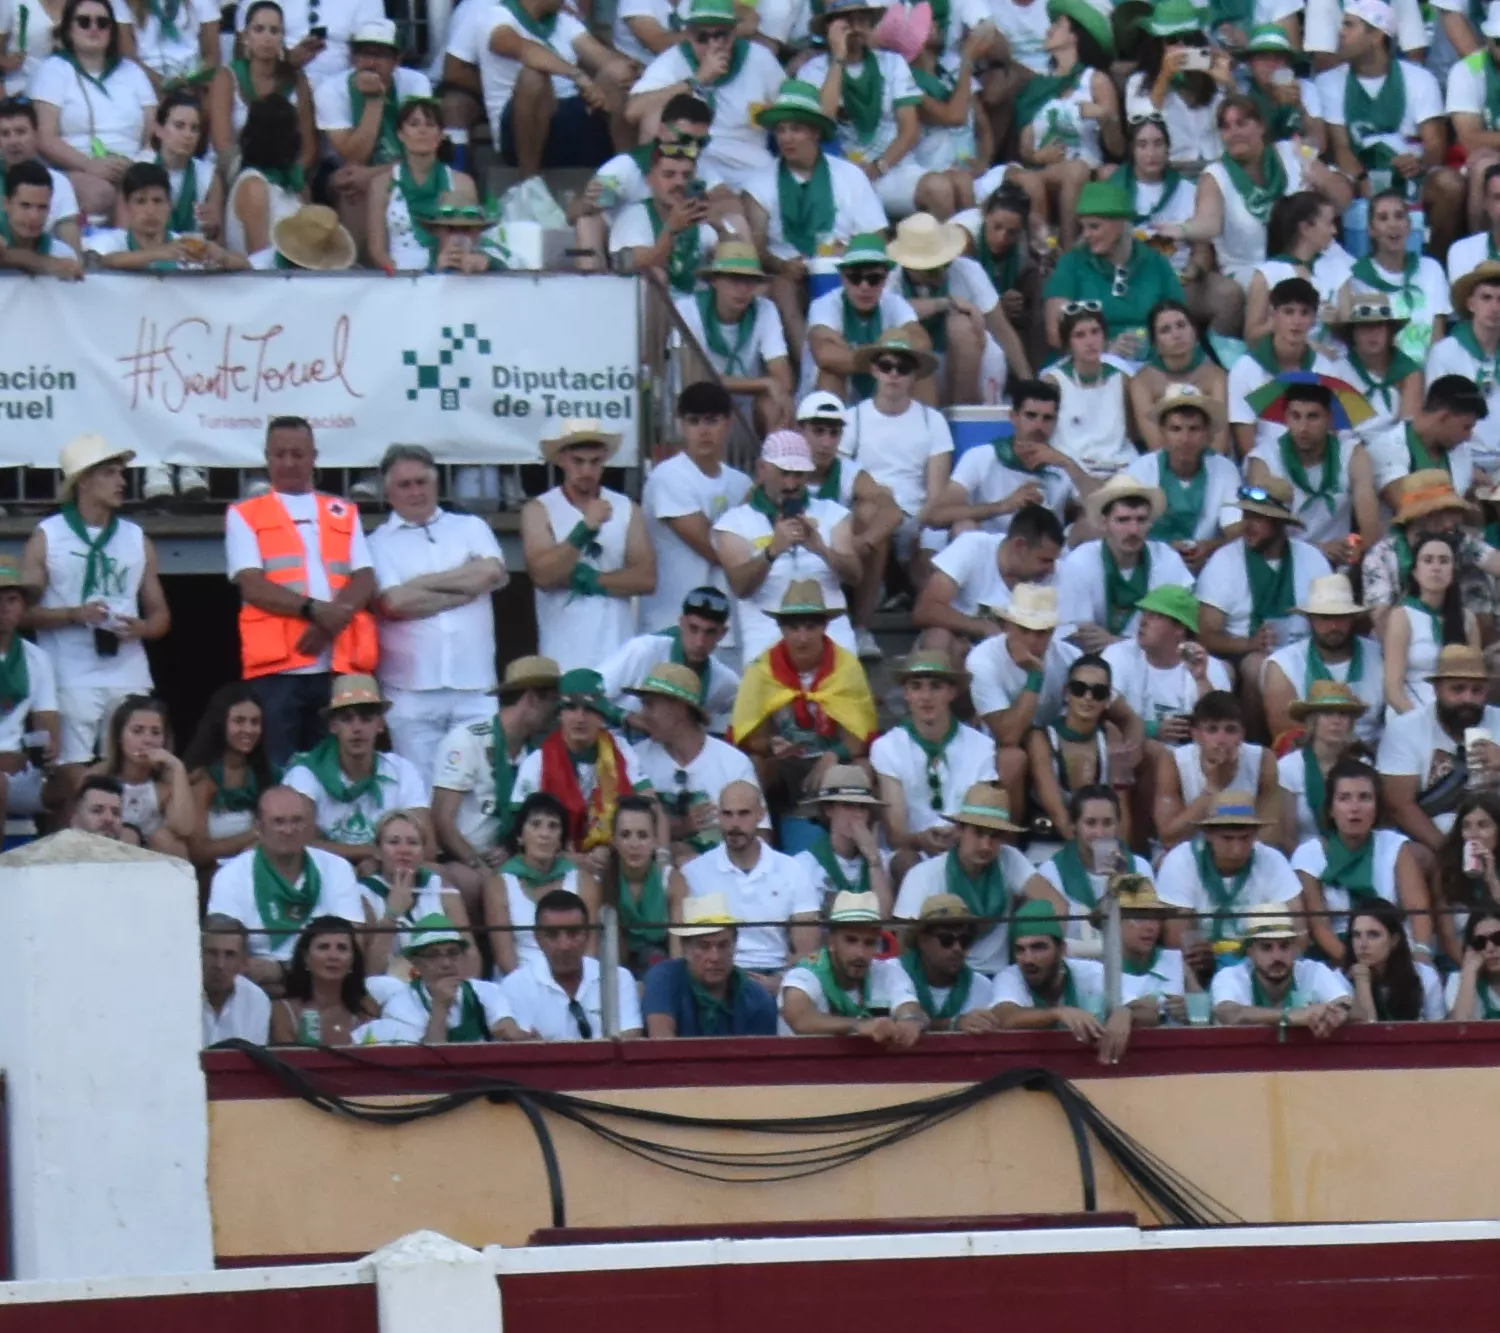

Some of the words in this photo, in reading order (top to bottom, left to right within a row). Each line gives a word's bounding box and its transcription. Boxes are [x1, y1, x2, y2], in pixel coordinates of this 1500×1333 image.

[492, 365, 636, 394] Diputació
[493, 394, 531, 418] de
[541, 394, 631, 418] Teruel
